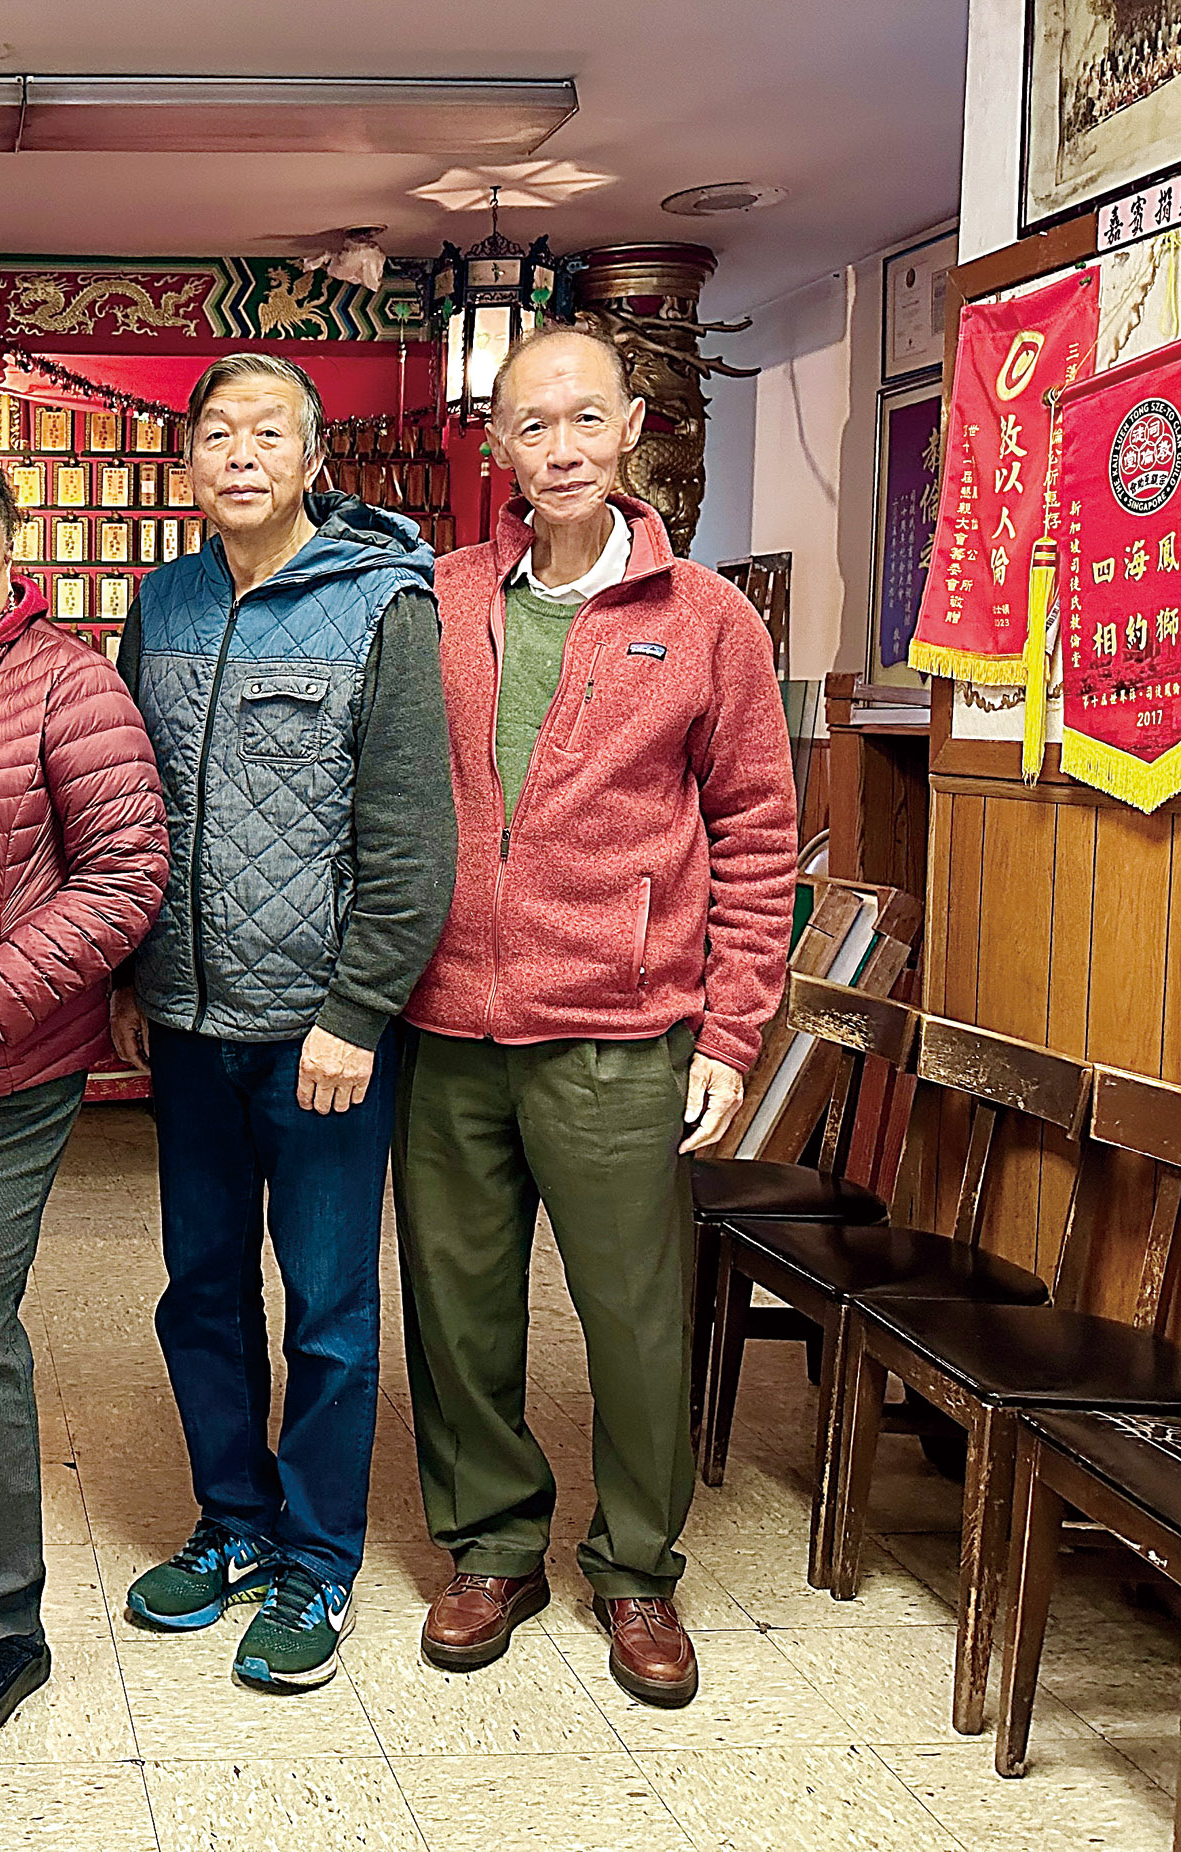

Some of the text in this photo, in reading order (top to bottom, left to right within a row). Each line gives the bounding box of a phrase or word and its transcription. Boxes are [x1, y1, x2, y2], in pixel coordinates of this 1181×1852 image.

[1104, 186, 1181, 245] 嘉賓捐
[1129, 404, 1149, 421] TONG
[1150, 402, 1175, 421] SZE-TO
[1114, 422, 1130, 450] LUEN
[1111, 455, 1119, 477] KAU
[1113, 478, 1126, 499] THE
[1128, 492, 1167, 511] SINGAPORE
[1136, 709, 1163, 727] 2017
